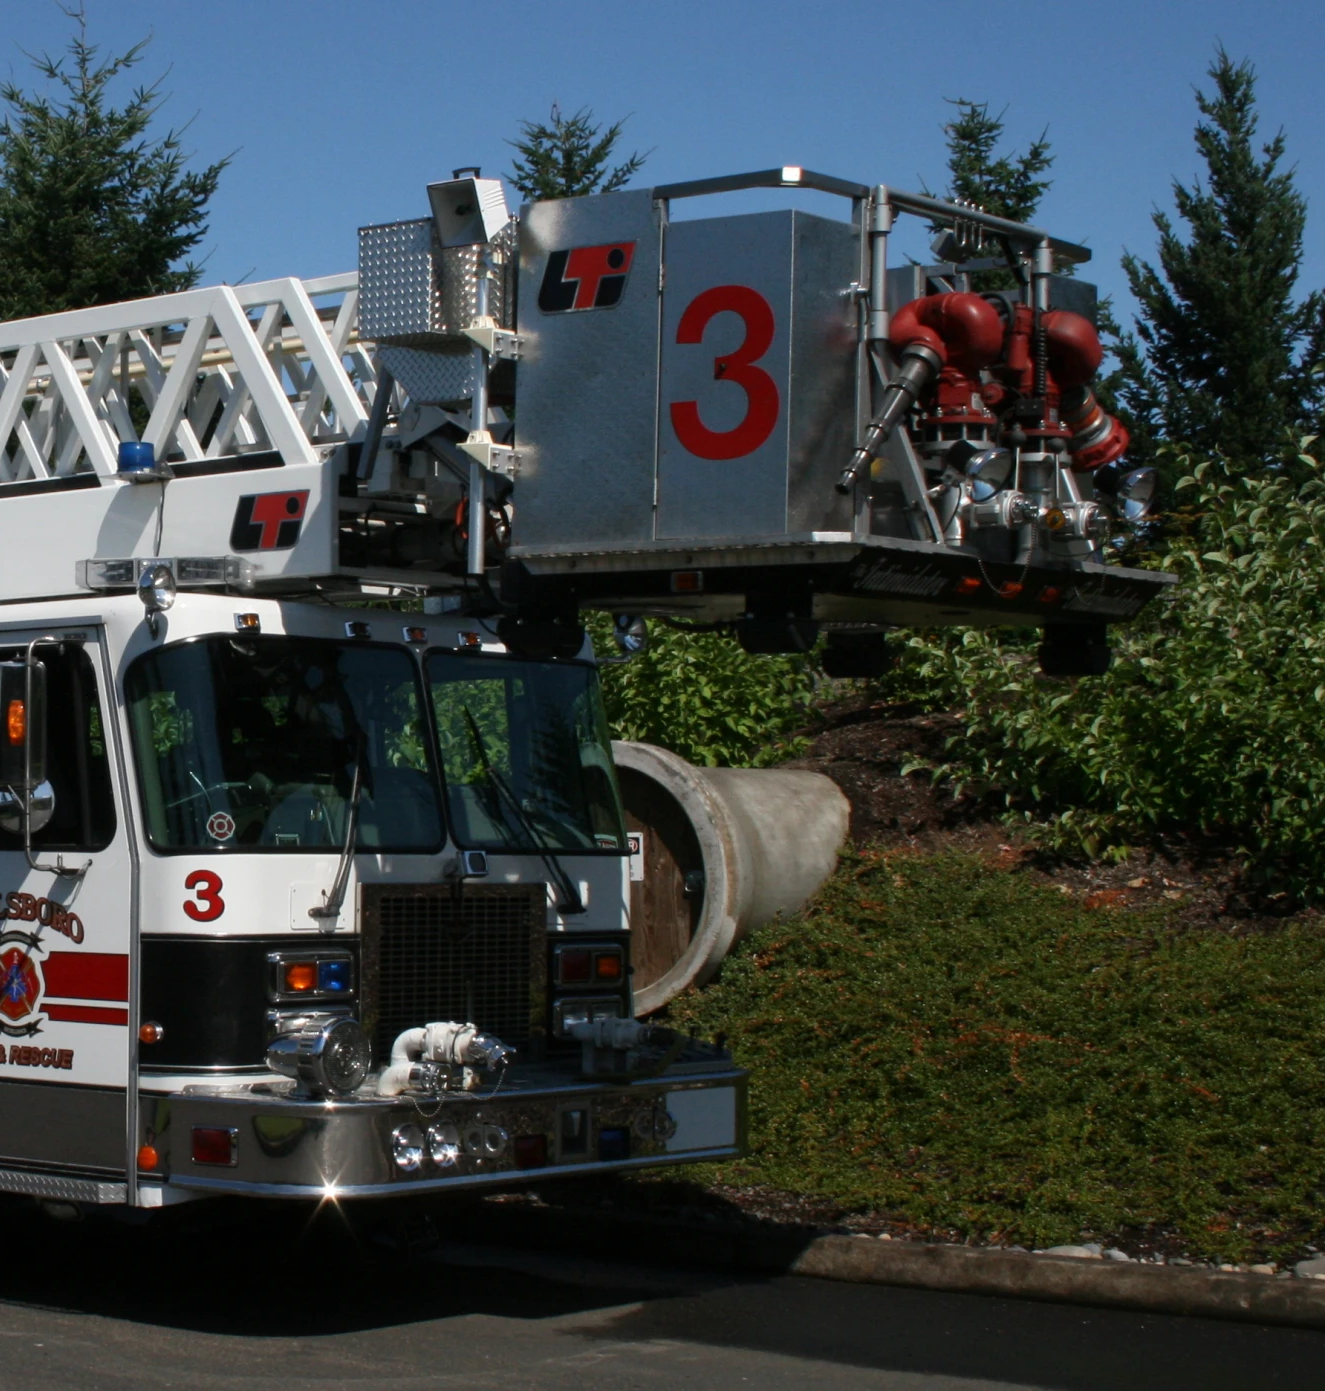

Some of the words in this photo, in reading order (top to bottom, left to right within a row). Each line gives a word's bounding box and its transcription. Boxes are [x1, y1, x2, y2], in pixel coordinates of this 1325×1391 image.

[670, 284, 780, 461] 3
[183, 869, 225, 922] 3
[8, 1044, 74, 1070] RESCUE
